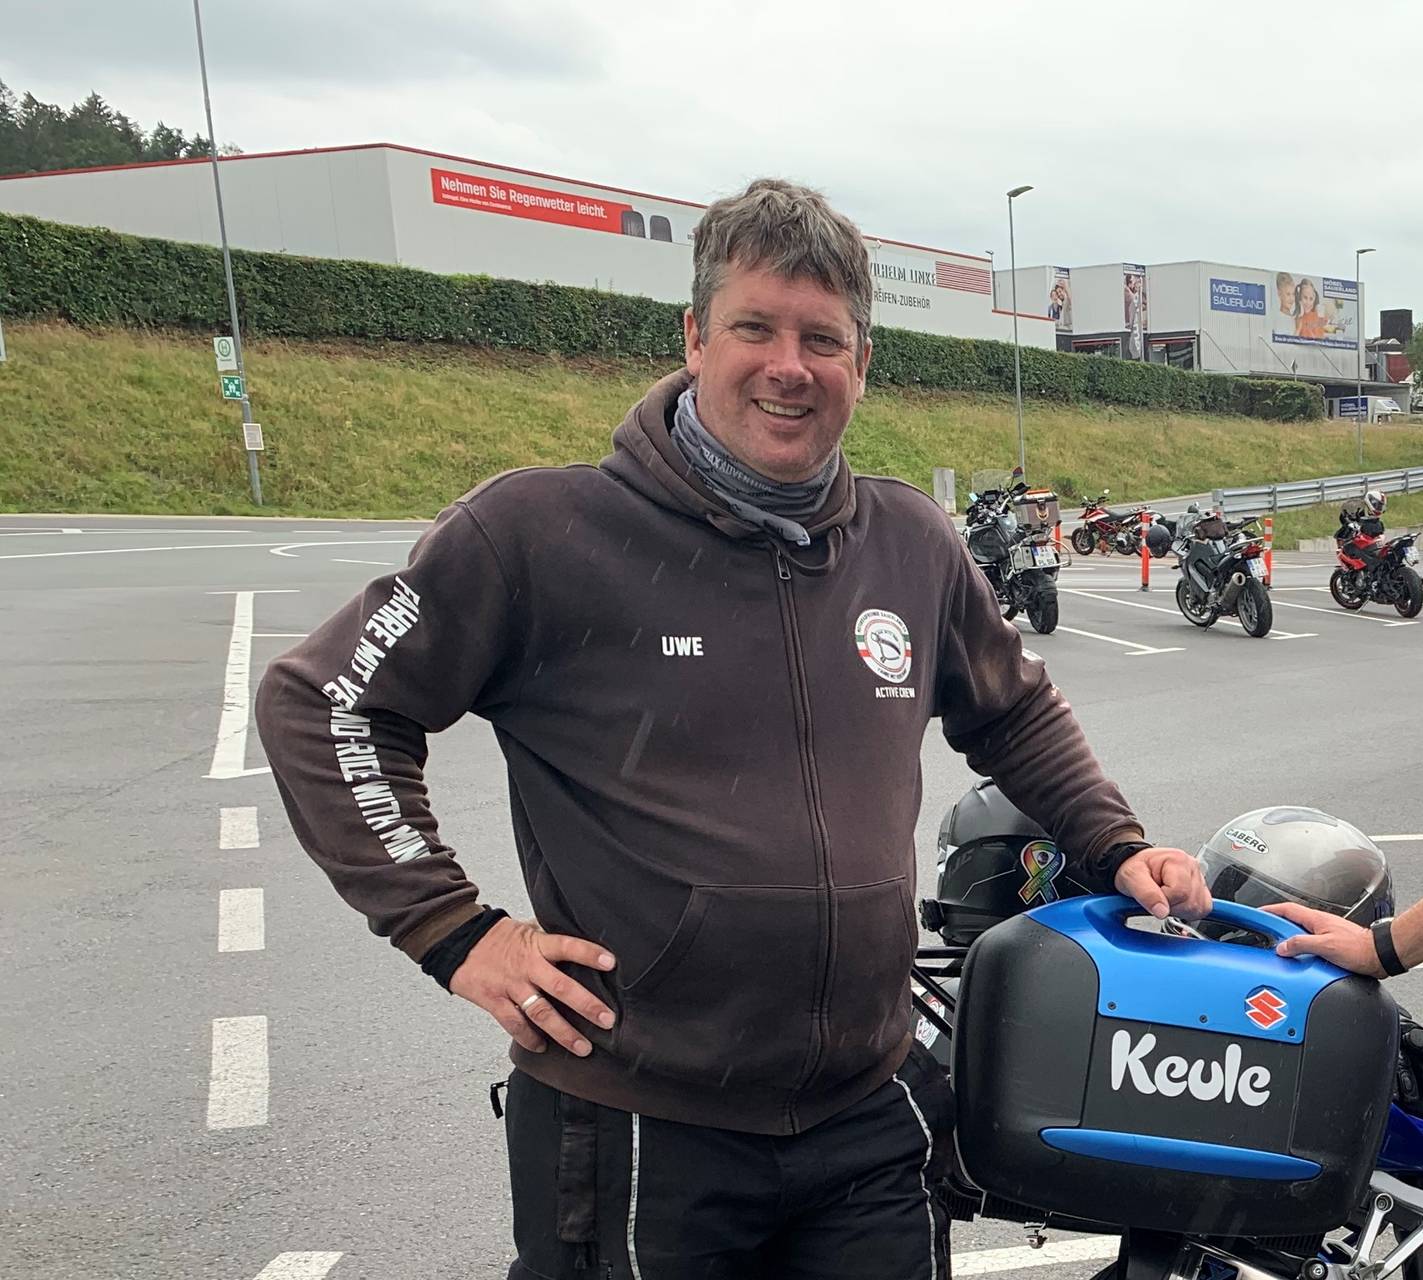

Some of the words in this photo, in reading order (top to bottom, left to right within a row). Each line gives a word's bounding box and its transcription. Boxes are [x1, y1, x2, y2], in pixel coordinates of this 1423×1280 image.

[440, 176, 487, 197] Nehmen
[489, 185, 507, 200] Sie
[509, 189, 575, 212] Regenwetter
[576, 201, 608, 218] leicht.
[1212, 283, 1243, 296] MÖBEL
[1212, 295, 1264, 310] SAUERLAND
[365, 575, 421, 648] FAHRE
[350, 635, 386, 684] MIT
[661, 635, 704, 657] UWE
[875, 687, 900, 699] ACTIVE
[899, 687, 916, 699] CREW
[351, 780, 402, 837] WITH
[1226, 829, 1267, 852] CABERG
[1111, 1030, 1271, 1107] Keule
